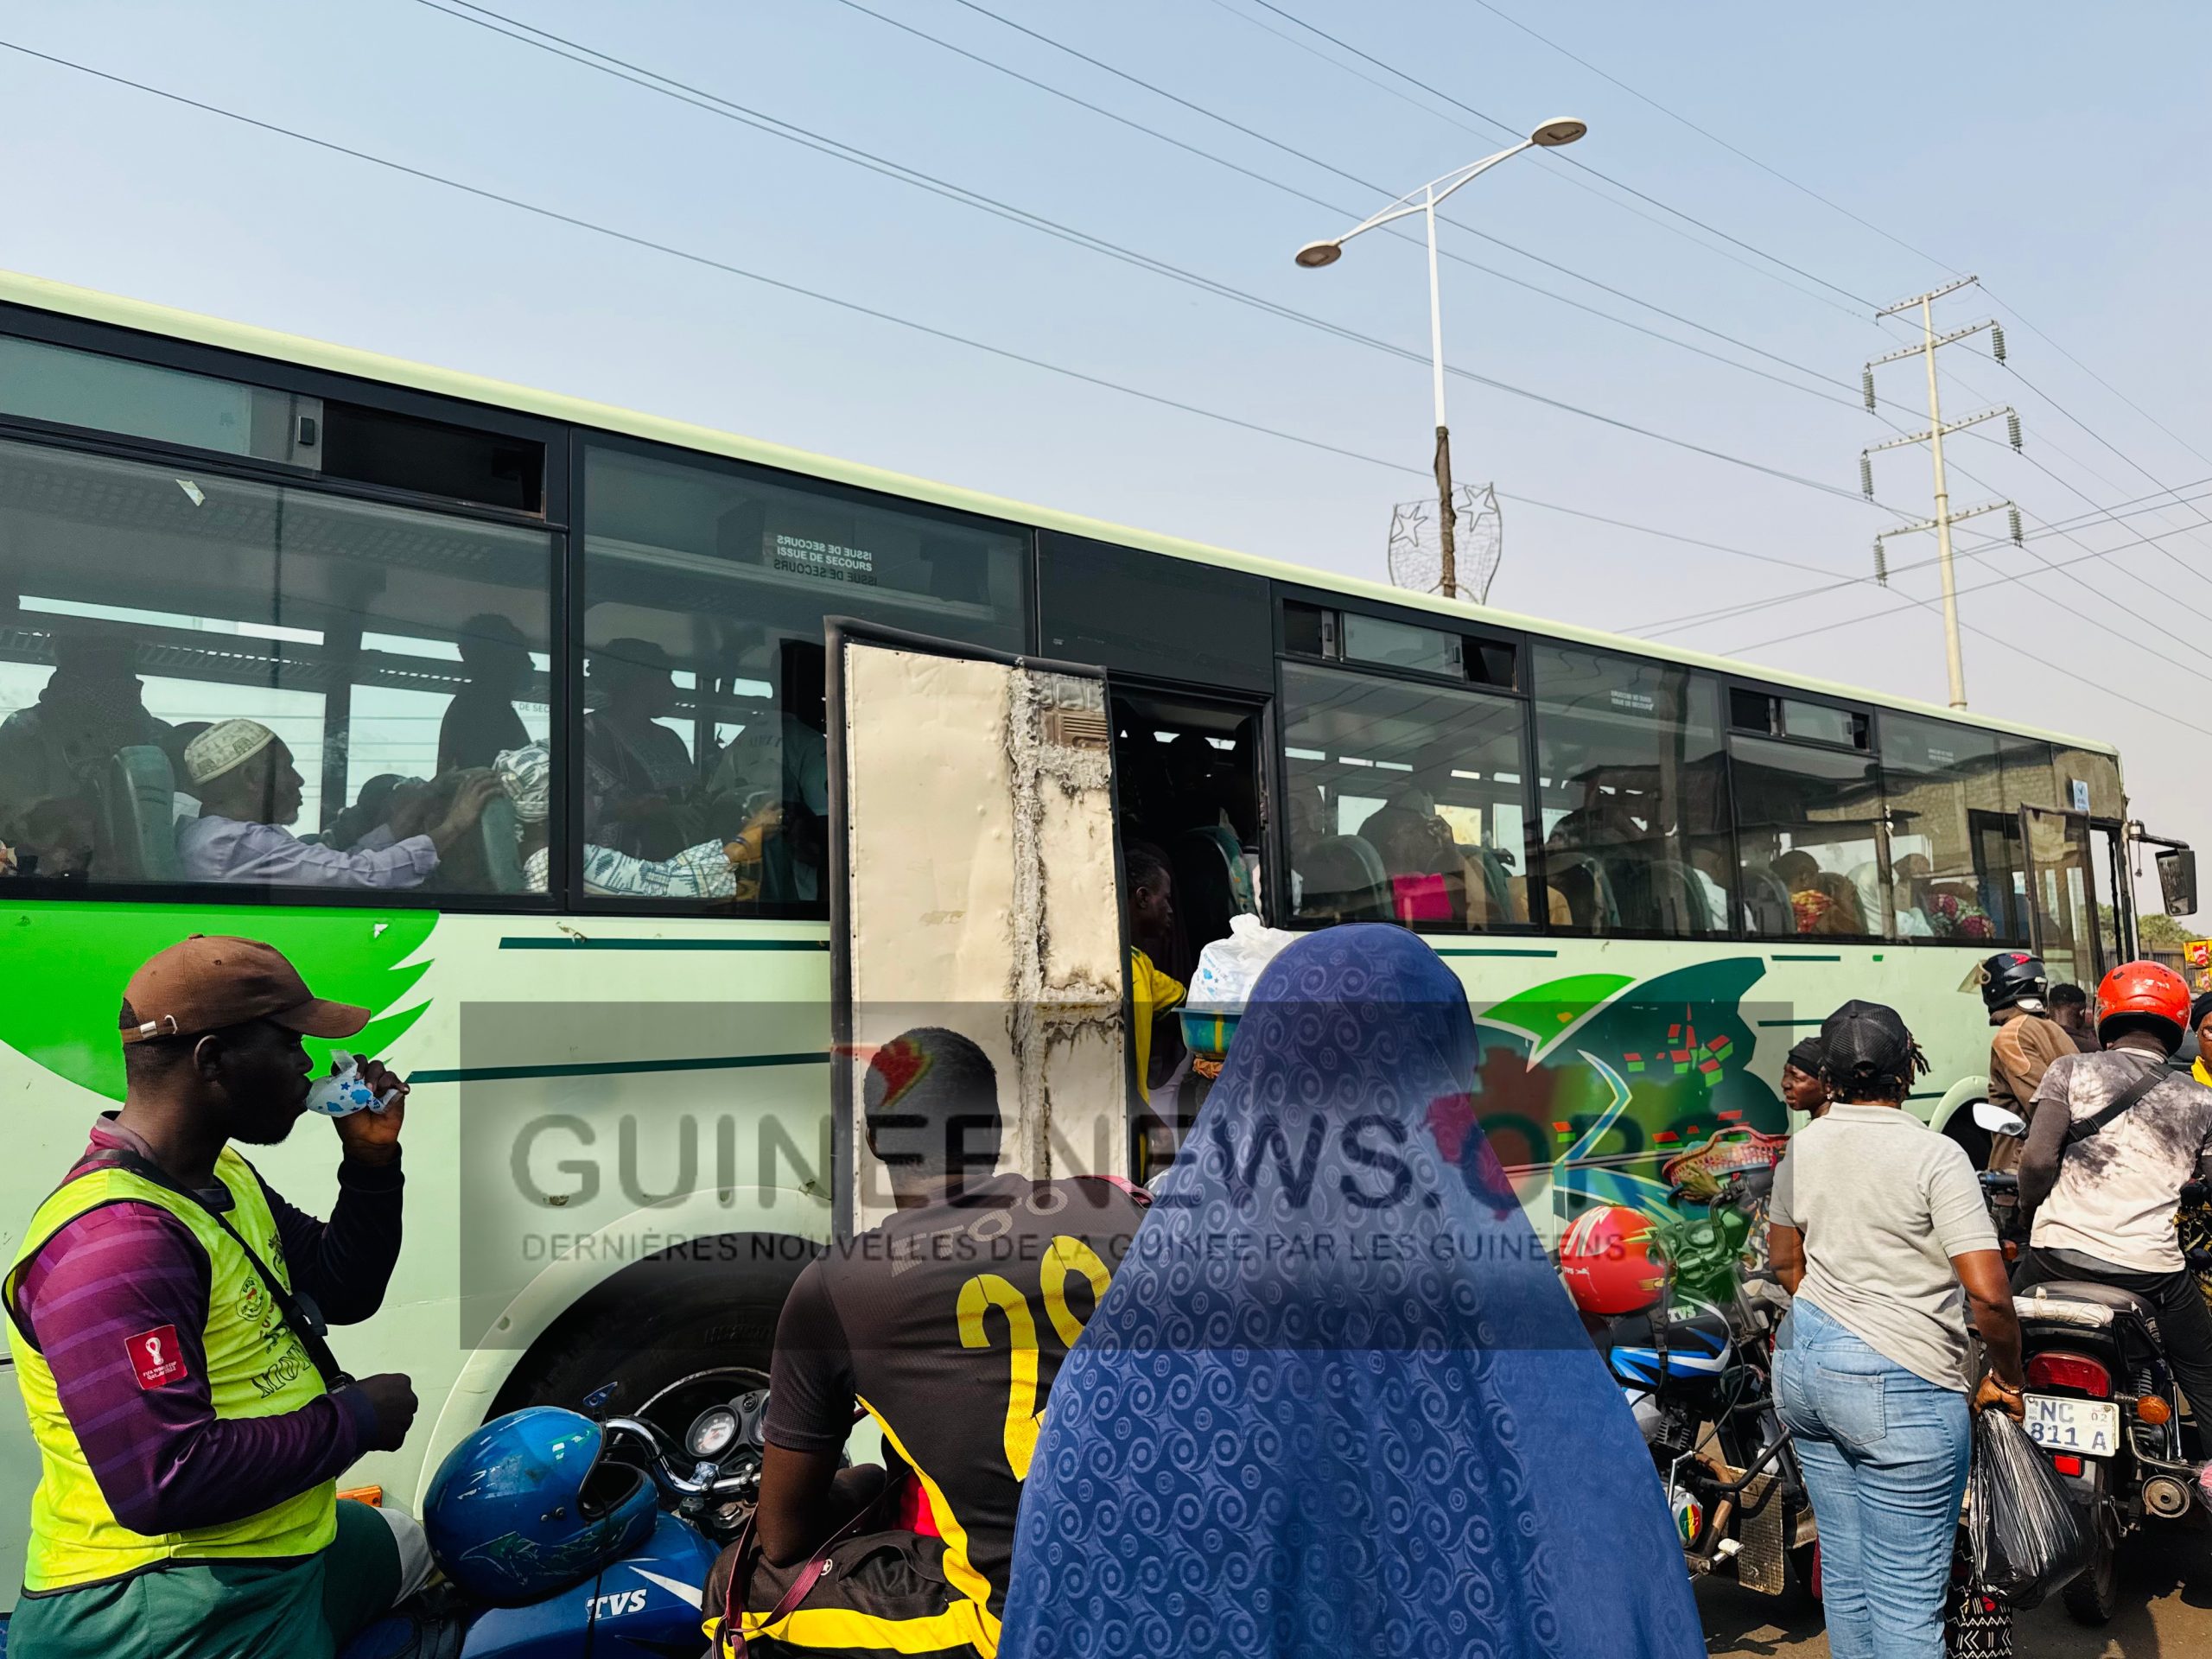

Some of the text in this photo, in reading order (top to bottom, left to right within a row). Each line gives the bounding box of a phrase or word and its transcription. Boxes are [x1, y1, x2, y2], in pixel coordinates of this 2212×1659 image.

[777, 546, 873, 572] ISSUE DE SECOURS
[1668, 1305, 1696, 1323] TVS
[2040, 1401, 2075, 1424] NC
[2031, 1422, 2107, 1452] 811 A
[586, 1588, 647, 1623] TVS
